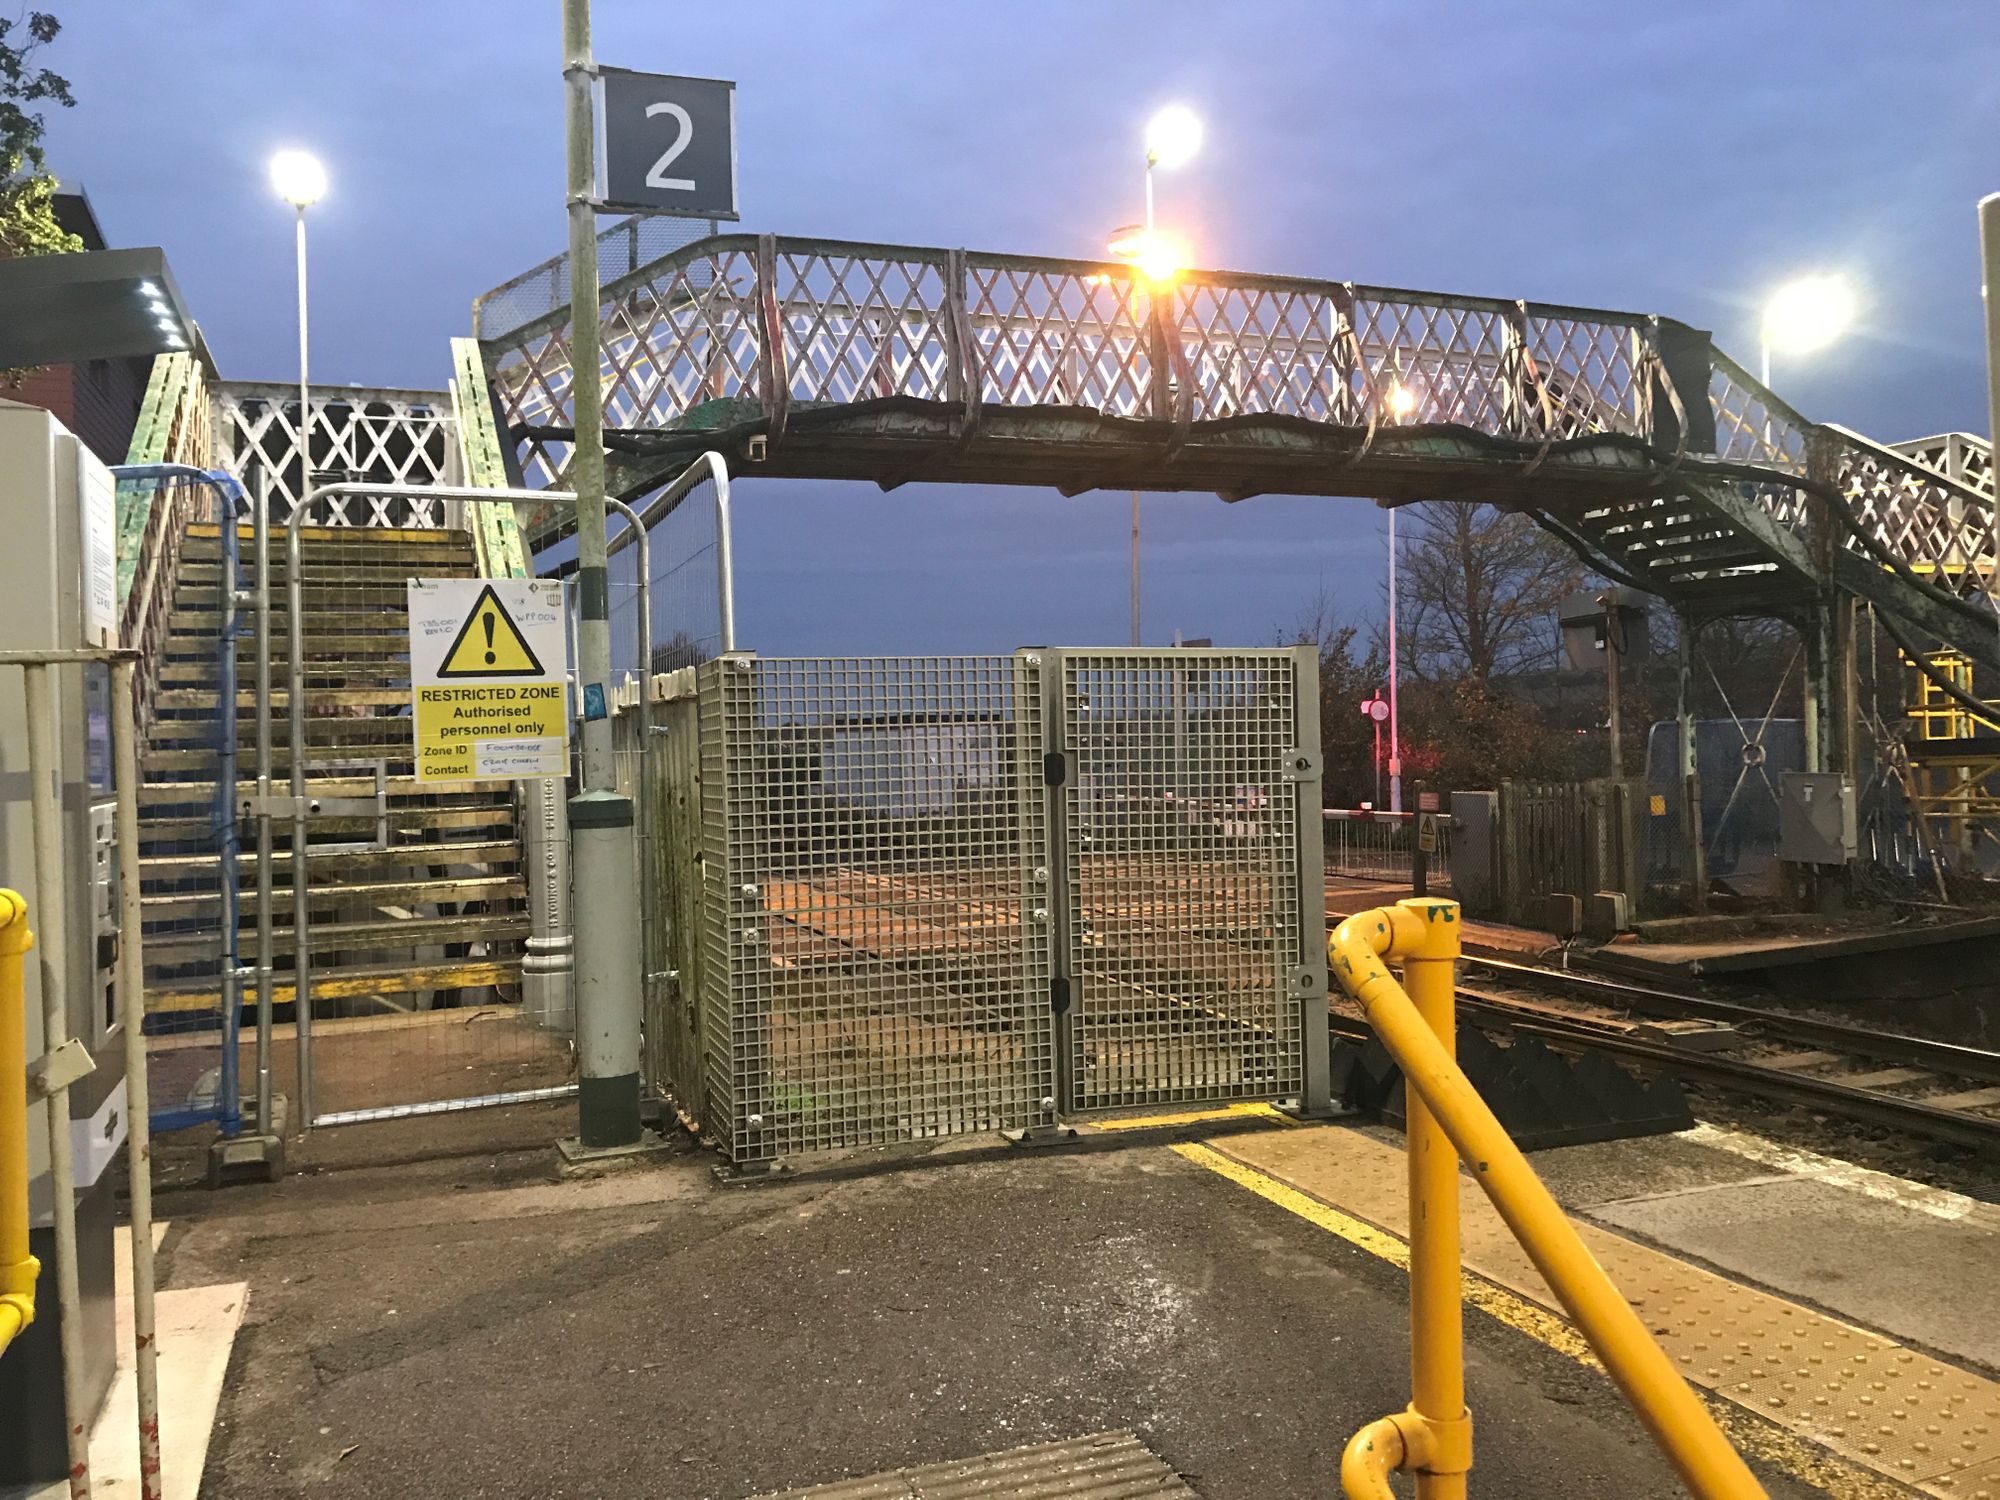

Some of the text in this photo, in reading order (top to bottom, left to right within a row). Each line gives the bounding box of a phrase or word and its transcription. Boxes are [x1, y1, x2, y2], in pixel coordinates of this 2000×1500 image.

[645, 102, 696, 191] 2
[421, 687, 560, 702] RESTRICTED ZONE
[453, 705, 531, 719] Authorised
[440, 721, 545, 739] personnel only
[424, 745, 468, 757] Zone ID
[425, 765, 469, 775] Contact
